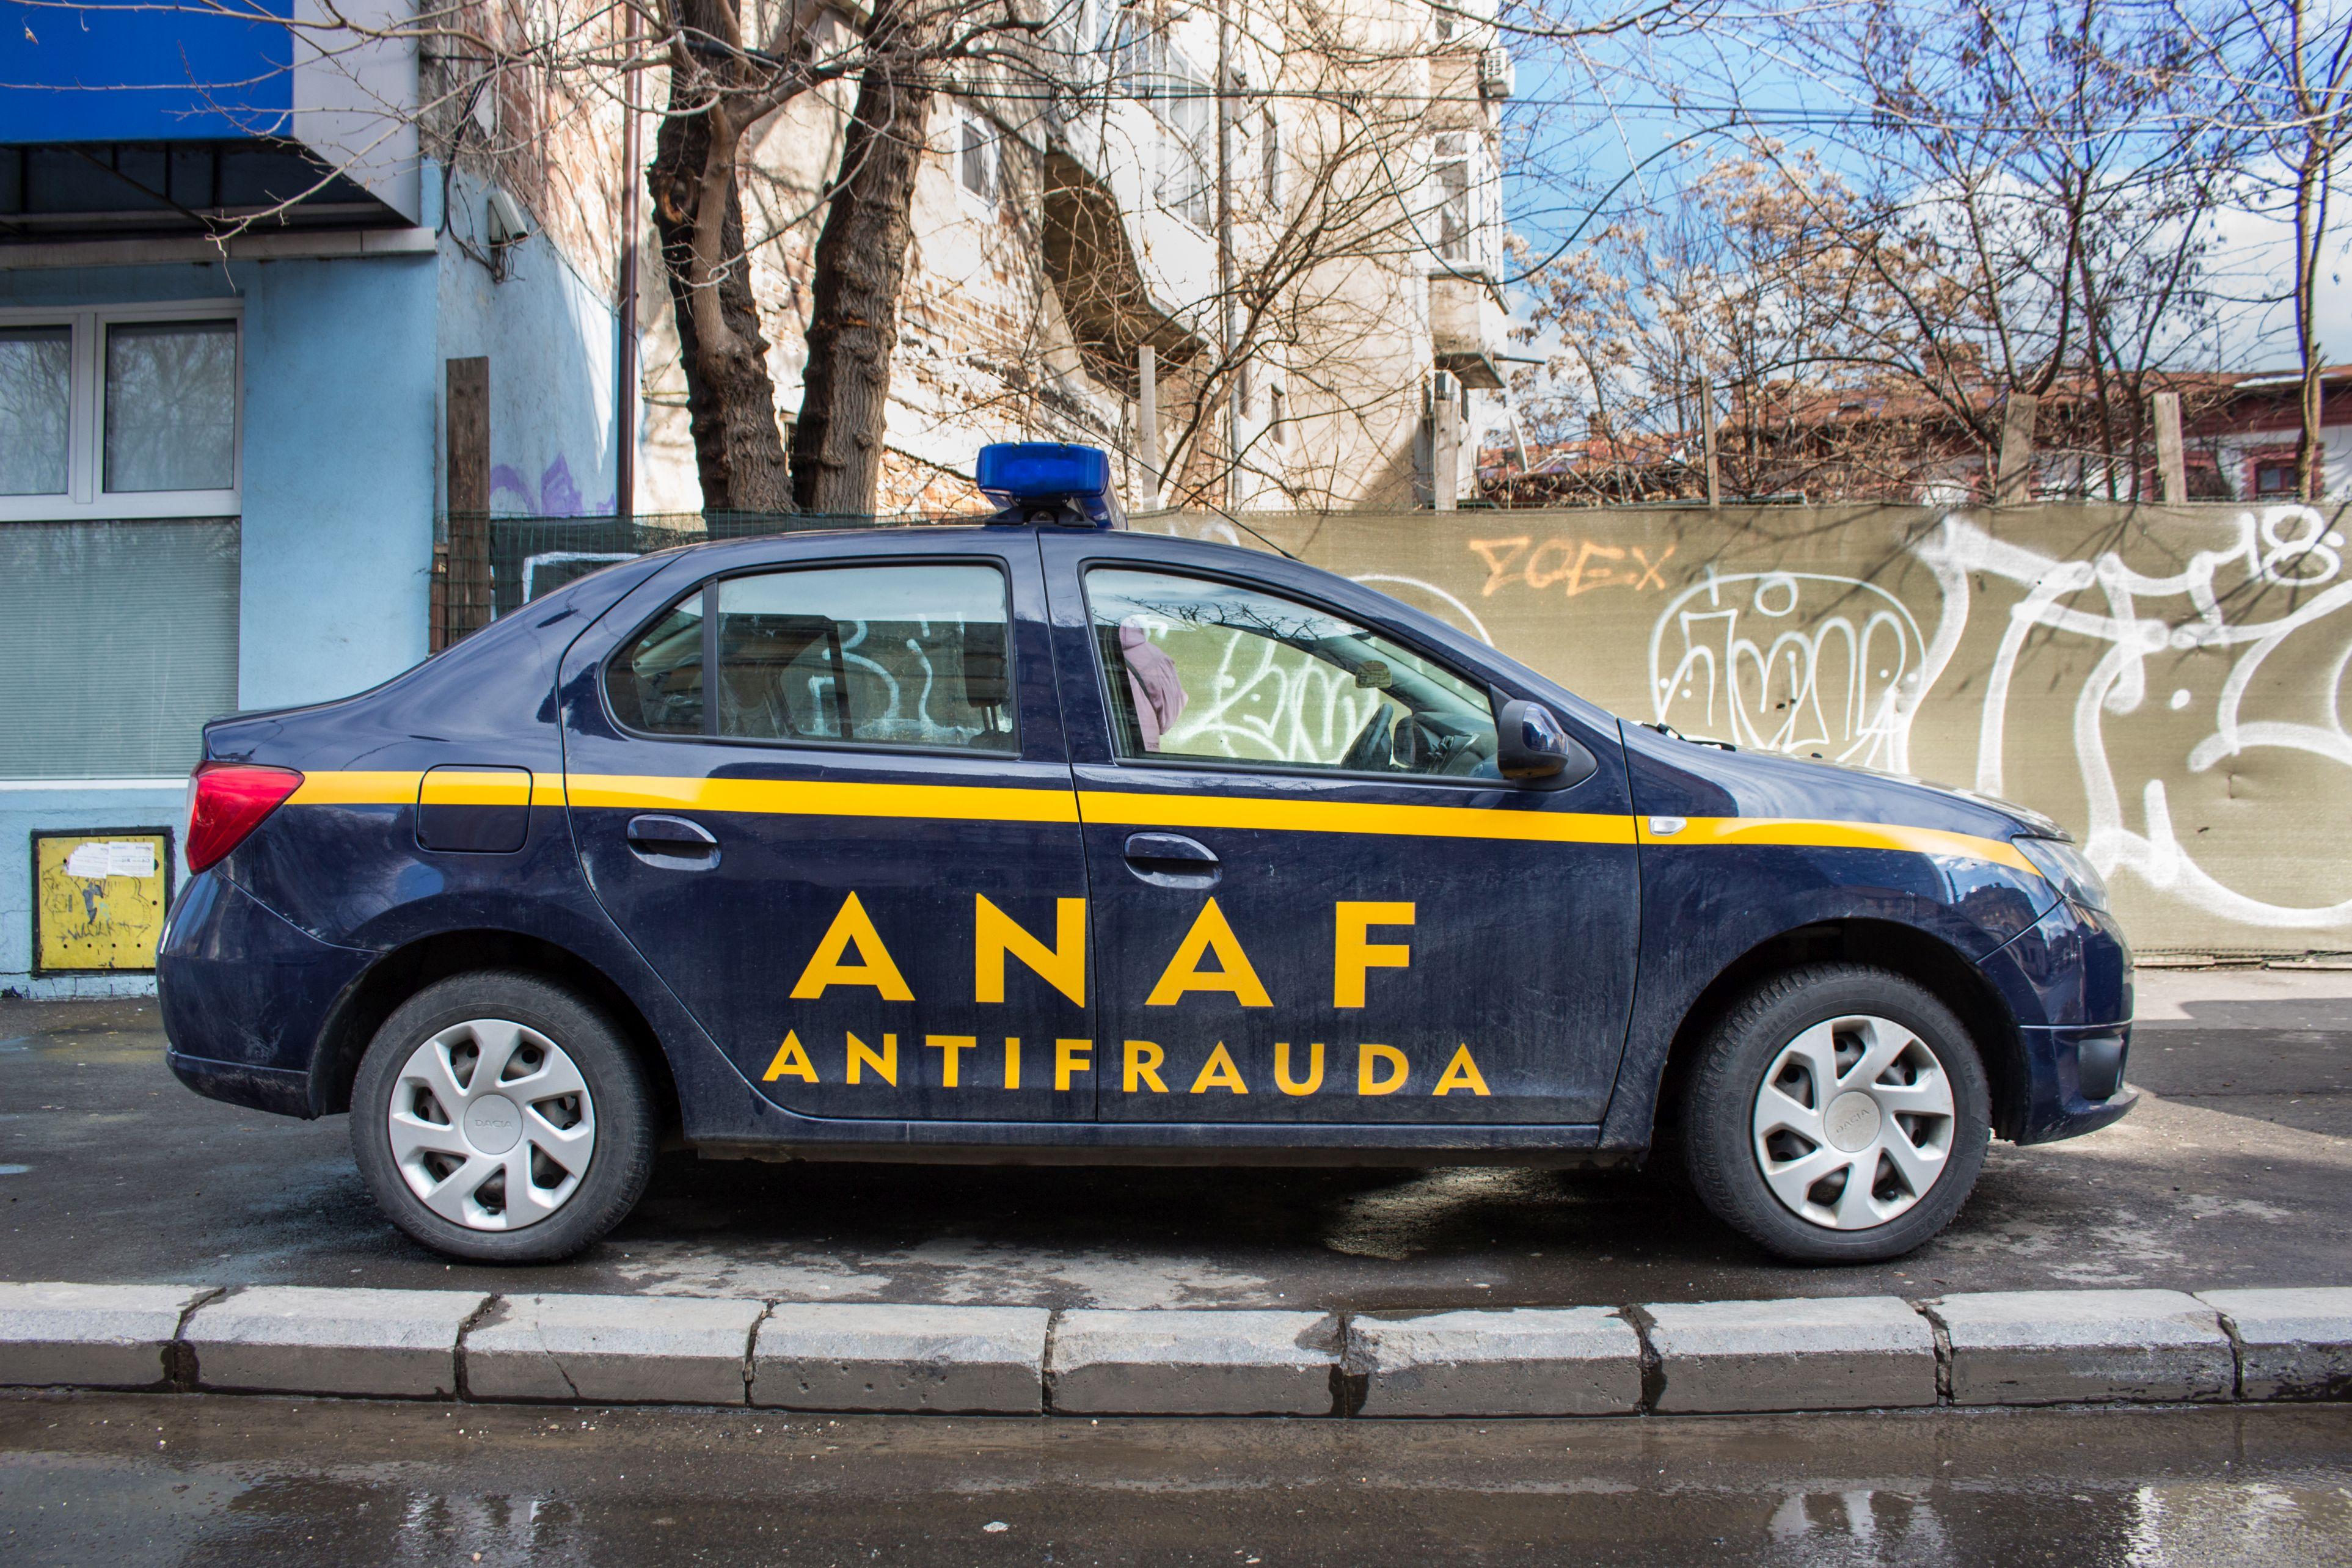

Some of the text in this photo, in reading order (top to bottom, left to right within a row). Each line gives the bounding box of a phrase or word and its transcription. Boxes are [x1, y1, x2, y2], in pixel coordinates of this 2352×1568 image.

[789, 890, 1417, 1009] ANAF
[761, 1029, 1492, 1097] ANTIFRAUDA
[475, 1119, 513, 1129] DACIA
[1836, 1109, 1870, 1133] DACIA
